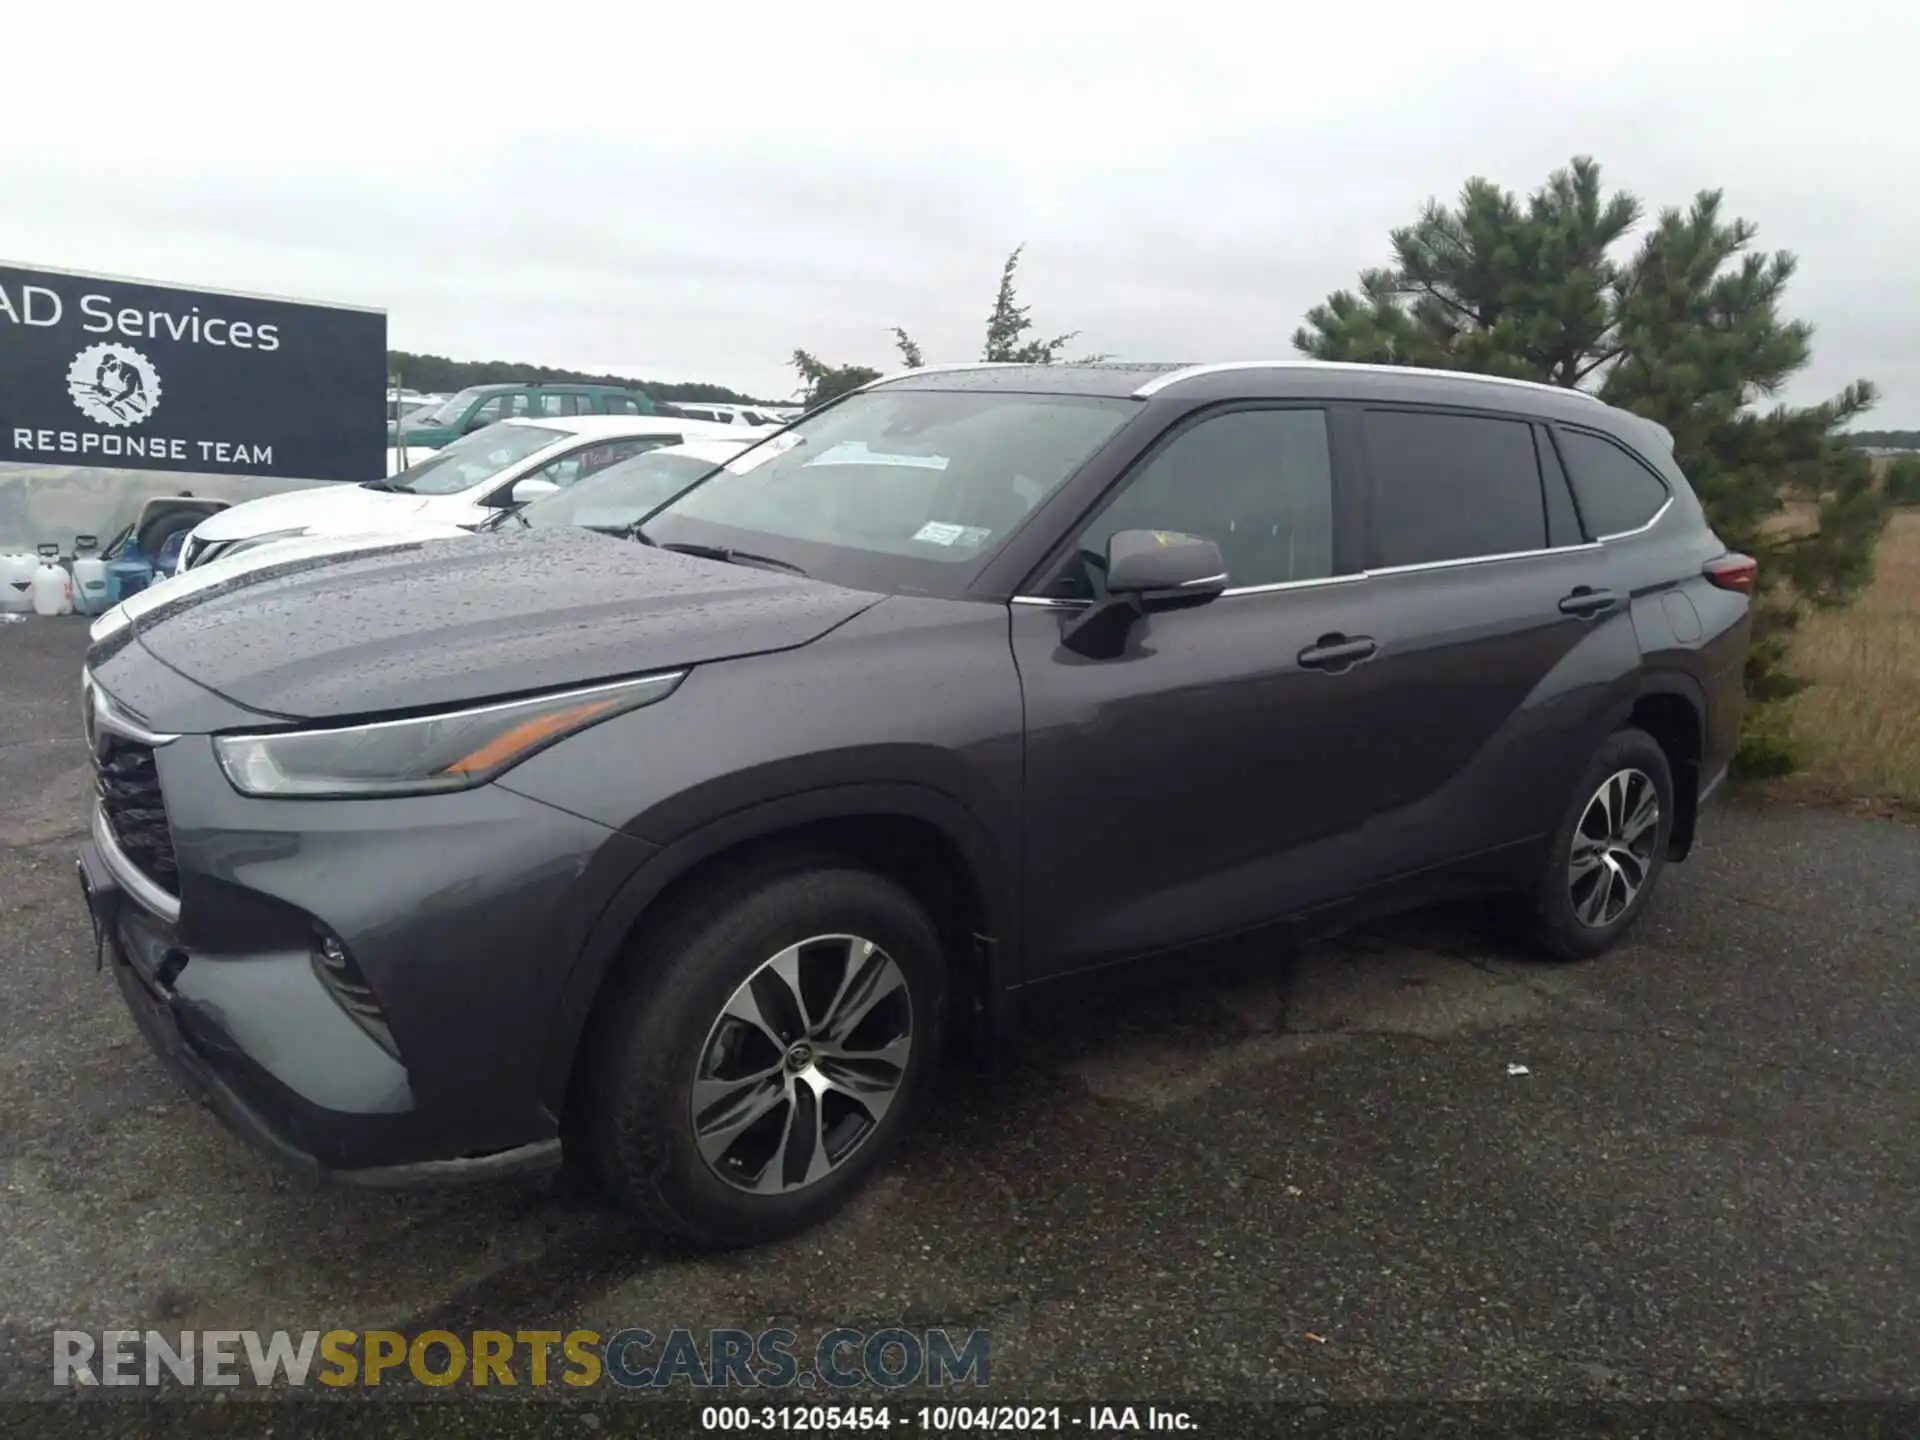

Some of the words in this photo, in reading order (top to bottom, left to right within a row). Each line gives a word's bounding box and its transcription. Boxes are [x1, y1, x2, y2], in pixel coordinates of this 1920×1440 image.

[80, 294, 280, 351] Services
[13, 427, 187, 460] RESPONSE
[197, 441, 273, 465] TEAM
